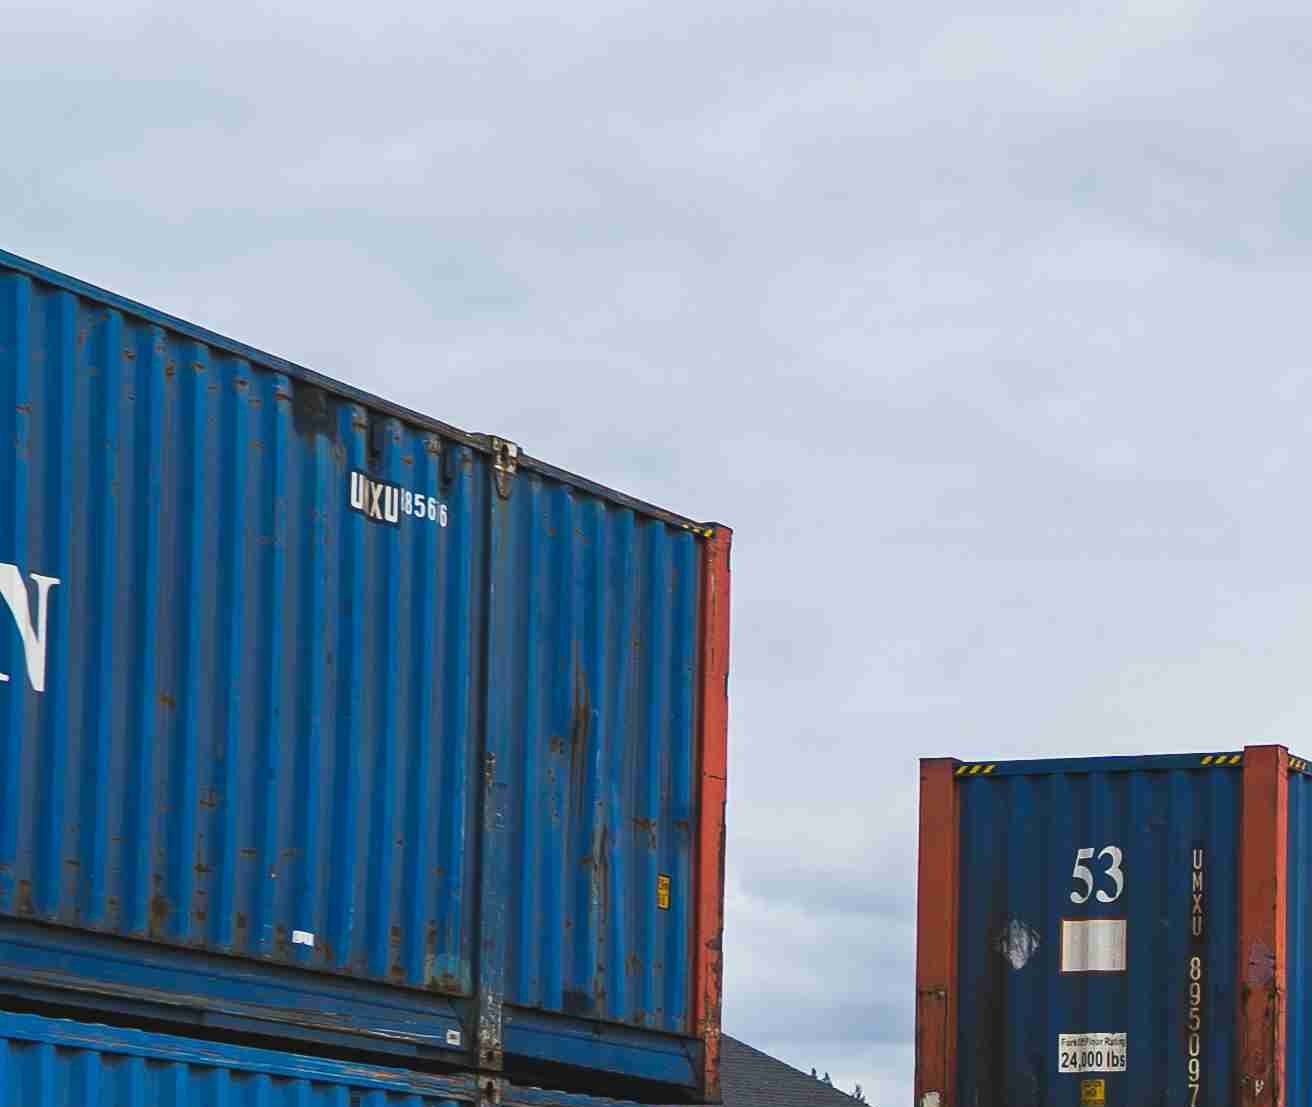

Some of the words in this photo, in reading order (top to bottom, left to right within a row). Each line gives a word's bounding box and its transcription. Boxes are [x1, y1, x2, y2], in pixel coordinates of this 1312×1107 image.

[1070, 846, 1124, 904] 53
[1192, 849, 1203, 937] UMXU
[1061, 1050, 1102, 1068] 24,000
[1106, 1050, 1126, 1068] lbs
